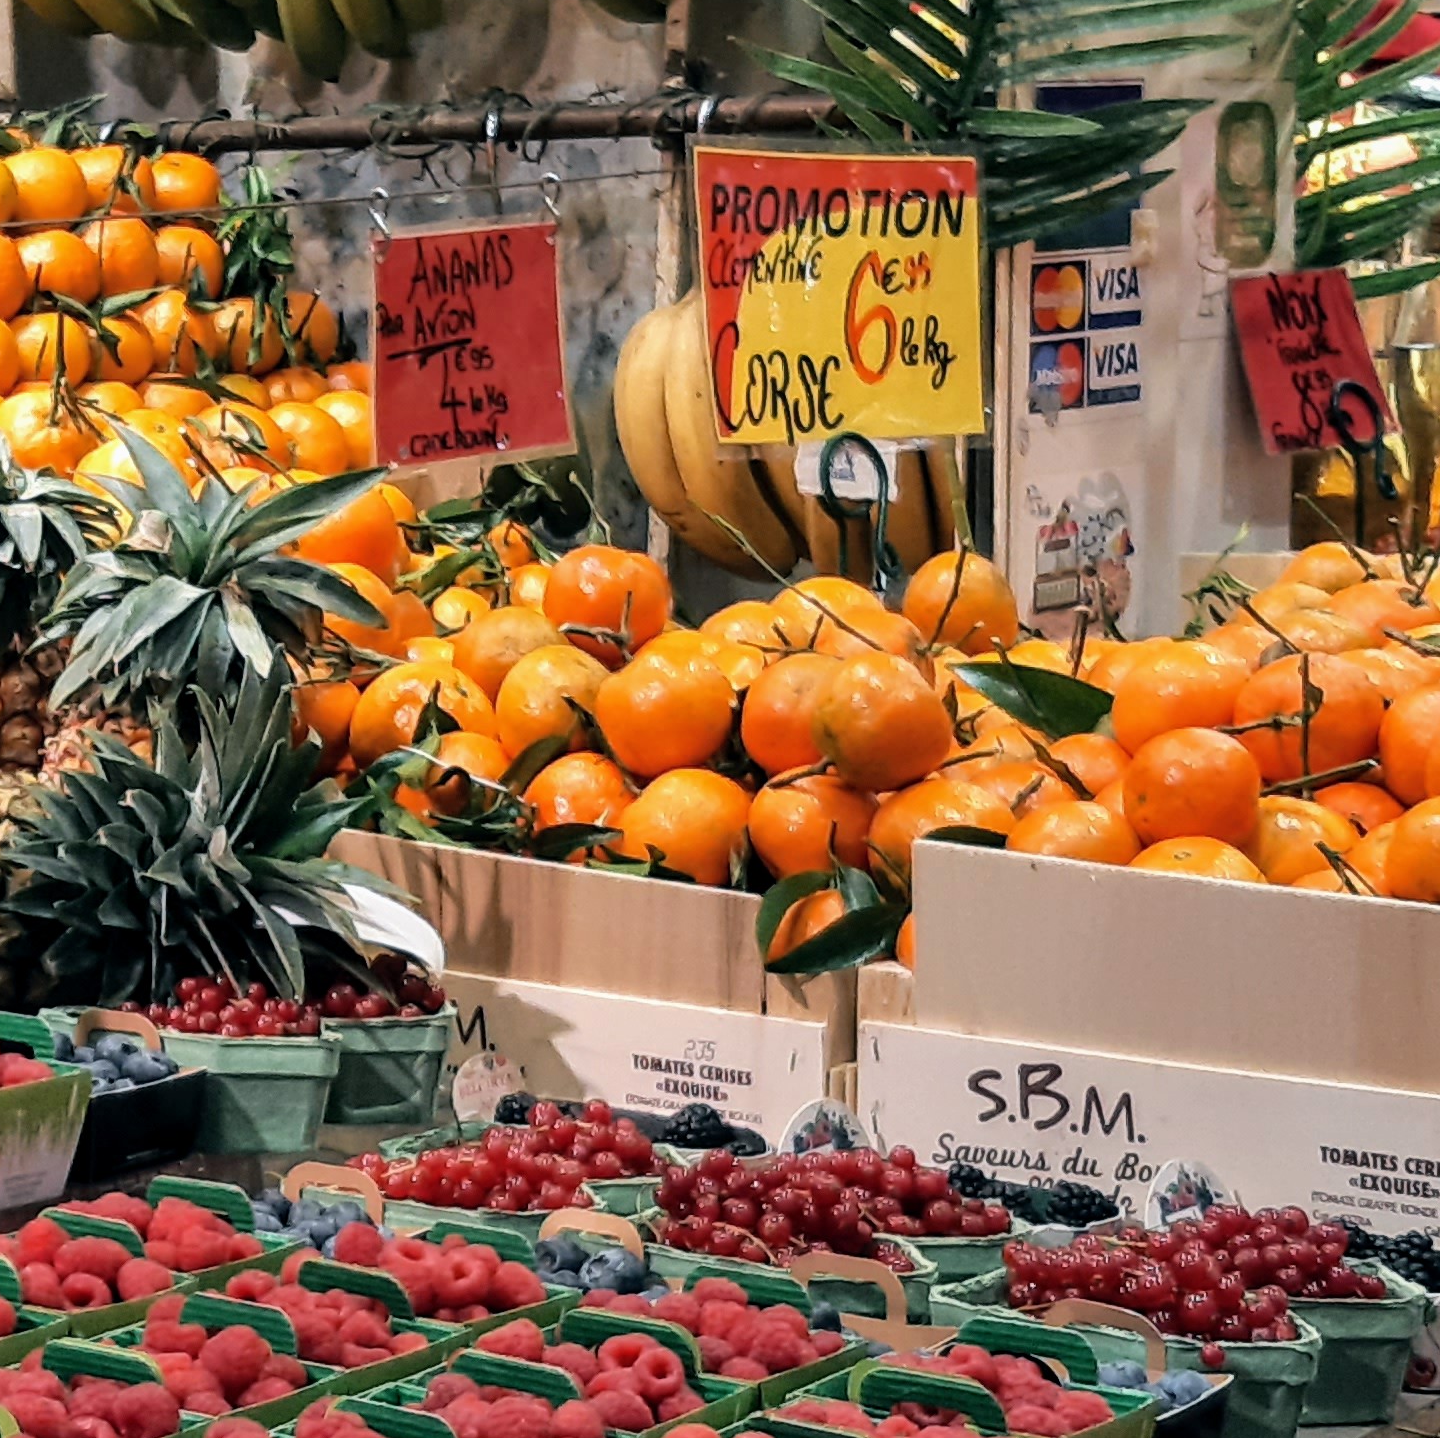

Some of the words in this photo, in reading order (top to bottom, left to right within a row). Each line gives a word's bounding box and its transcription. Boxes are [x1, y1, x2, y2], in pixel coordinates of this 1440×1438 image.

[711, 184, 964, 238] PROMOTION
[408, 235, 513, 303] ANANAS
[1096, 266, 1140, 301] VISA
[1095, 343, 1138, 377] VISA
[714, 321, 844, 445] CORSE
[632, 1053, 694, 1078] TOMATES
[700, 1064, 752, 1086] CERISES
[968, 1063, 1146, 1143] S.B.M.
[932, 1133, 1051, 1171] Saveurs
[1062, 1147, 1102, 1177] du
[1320, 1146, 1398, 1172] TOMATES
